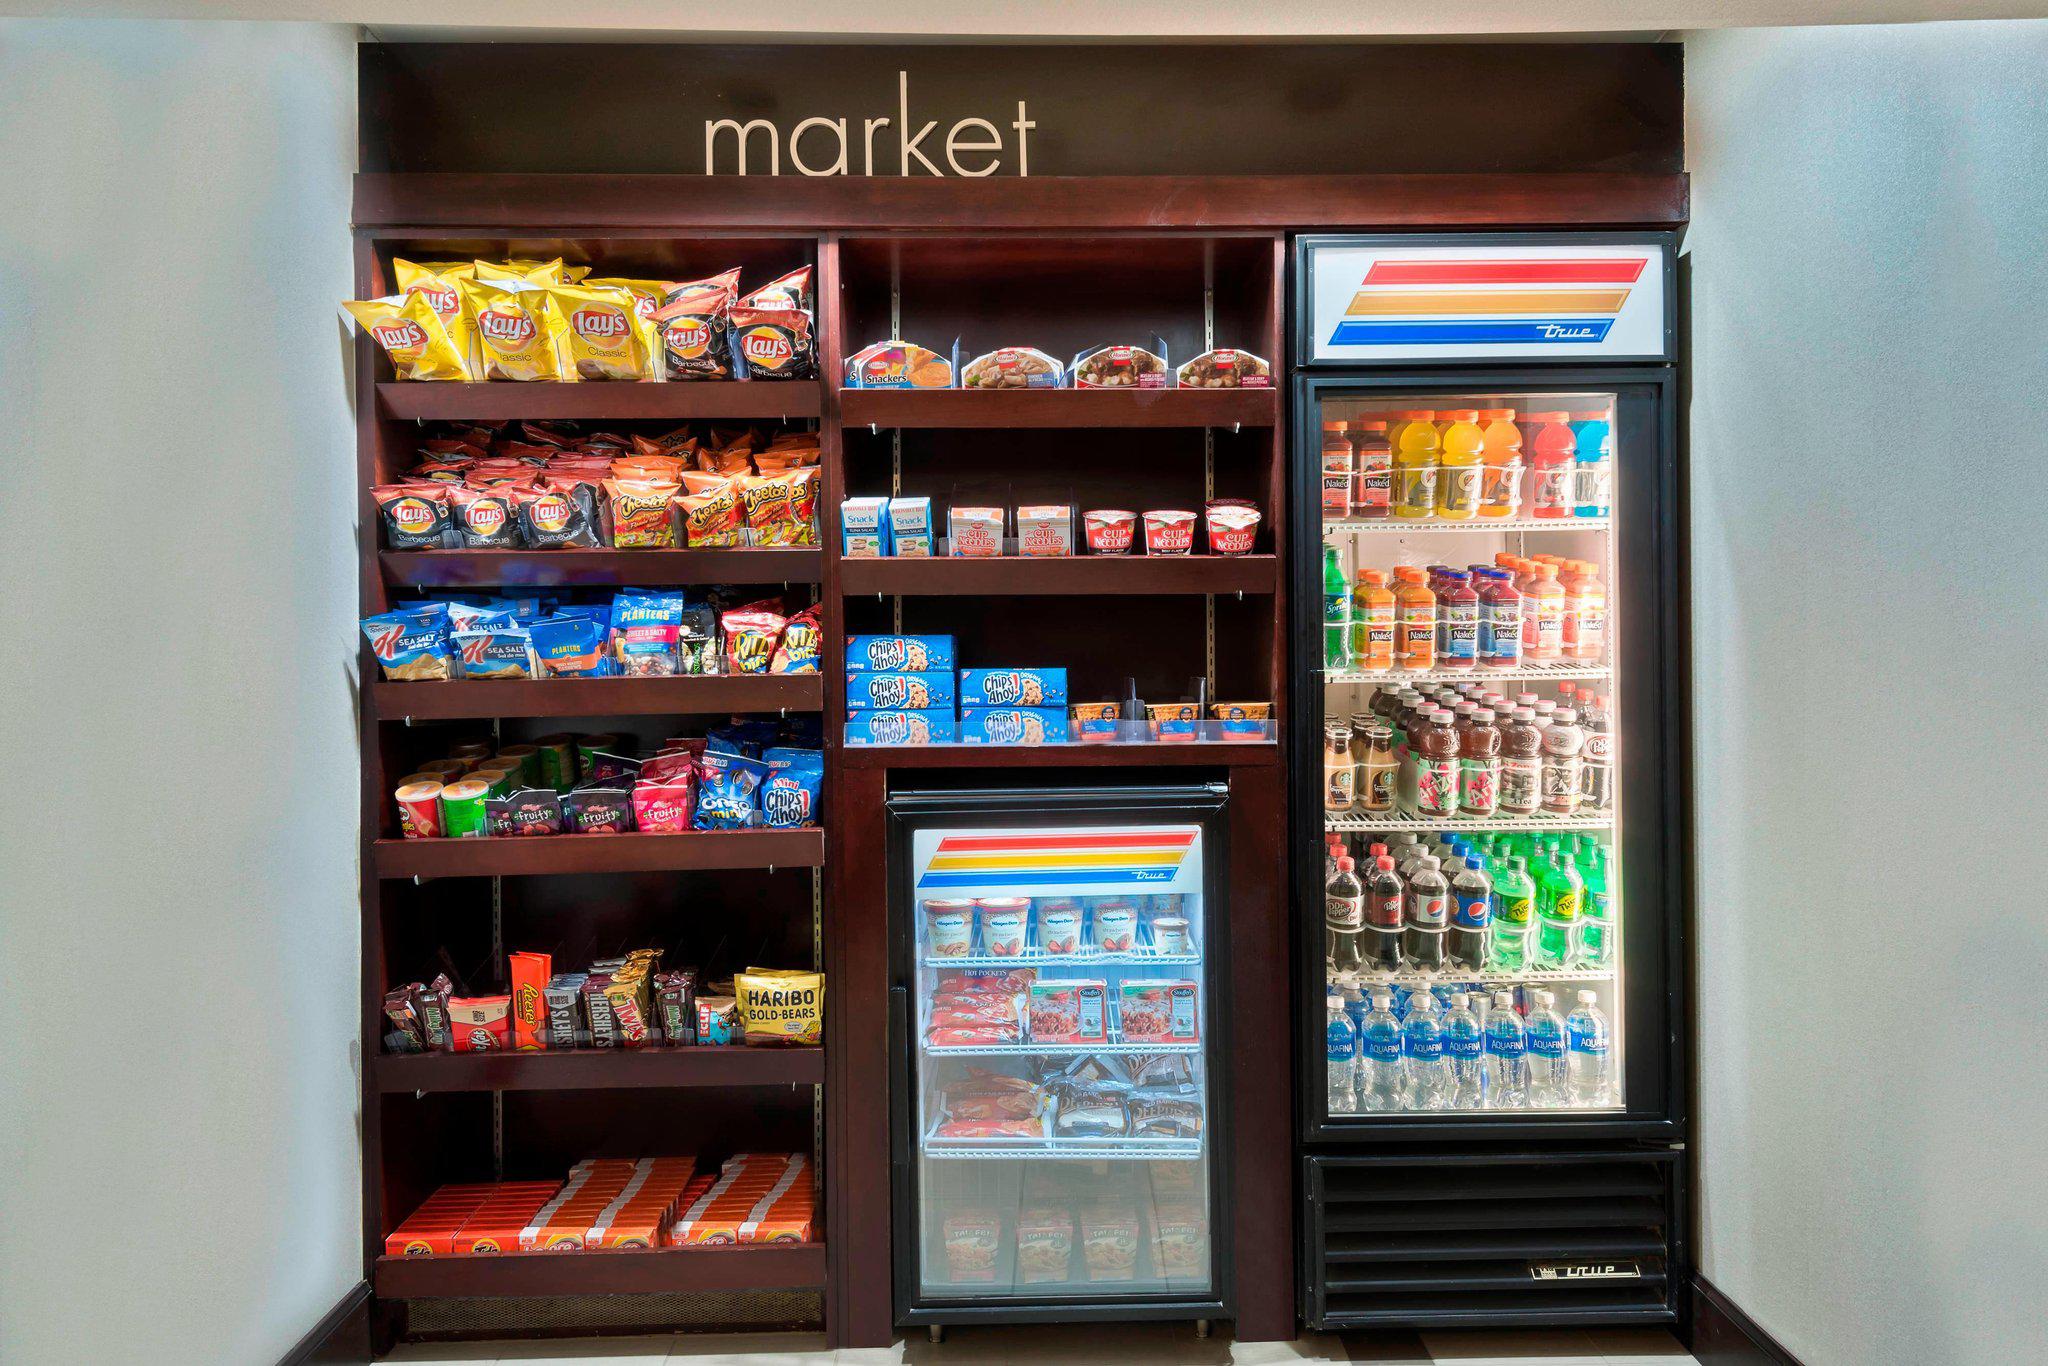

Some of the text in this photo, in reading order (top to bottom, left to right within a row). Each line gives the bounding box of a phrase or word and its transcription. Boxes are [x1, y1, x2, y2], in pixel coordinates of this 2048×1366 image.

[705, 71, 1036, 177] market
[483, 310, 531, 340] Lay's
[577, 312, 625, 337] Lay's
[374, 319, 422, 350] Lay's
[667, 325, 707, 348] Lay's
[588, 347, 627, 358] Classic
[747, 337, 788, 359] Lay's
[672, 356, 716, 367] Barbecue
[866, 374, 907, 384] Snackers
[1326, 480, 1349, 488] Naked
[1367, 479, 1390, 487] Naked
[745, 484, 788, 514] Cheetos
[620, 495, 668, 518] Cheetos
[397, 505, 431, 524] Lay's
[469, 508, 501, 526] Lay's
[535, 503, 566, 523] Lay's
[896, 517, 923, 525] Snack
[398, 534, 441, 544] Barbecue
[538, 530, 579, 542] Barbecue
[967, 530, 988, 539] CUP
[1034, 529, 1055, 538] CUP
[1104, 529, 1126, 539] CUP
[1163, 529, 1185, 539] CUP
[1226, 534, 1249, 543] CUP
[469, 537, 510, 546] Barbecue
[1095, 537, 1131, 547] NOODLES
[1155, 537, 1190, 547] NOODLES
[1217, 539, 1252, 550] NOODLES
[621, 609, 670, 622] PLANTERS
[399, 634, 435, 646] SEA SALT
[786, 629, 817, 649] RITZ
[1371, 632, 1392, 640] Naked
[1410, 631, 1433, 640] Naked
[1453, 630, 1476, 639] Naked
[374, 625, 405, 659] K
[734, 633, 769, 660] RITZ
[463, 635, 493, 664] K
[552, 645, 581, 655] PLANTERS
[869, 642, 897, 659] Chips
[870, 679, 899, 696] Chips
[984, 674, 1012, 691] Chips
[870, 713, 900, 731] Chips
[986, 713, 1014, 730] Chips
[773, 779, 800, 790] Mini
[702, 797, 750, 811] OREO
[766, 791, 802, 810] Chips
[519, 810, 550, 822] Fruity
[584, 810, 617, 823] Fruity
[647, 807, 680, 818] Fruity
[748, 989, 815, 1007] HARIBO
[523, 983, 539, 1026] Reese's
[750, 1007, 815, 1020] GOLD-BEARS
[590, 994, 614, 1047] HERSHEY'S
[614, 1000, 646, 1041] TWIX
[1370, 1043, 1400, 1054] AQUAFINA
[1413, 1042, 1442, 1053] AQUAFINA
[1450, 1041, 1480, 1052] AQUAFINA
[1492, 1040, 1524, 1050] AQUAFINA
[1533, 1039, 1566, 1050] AQUAFINA
